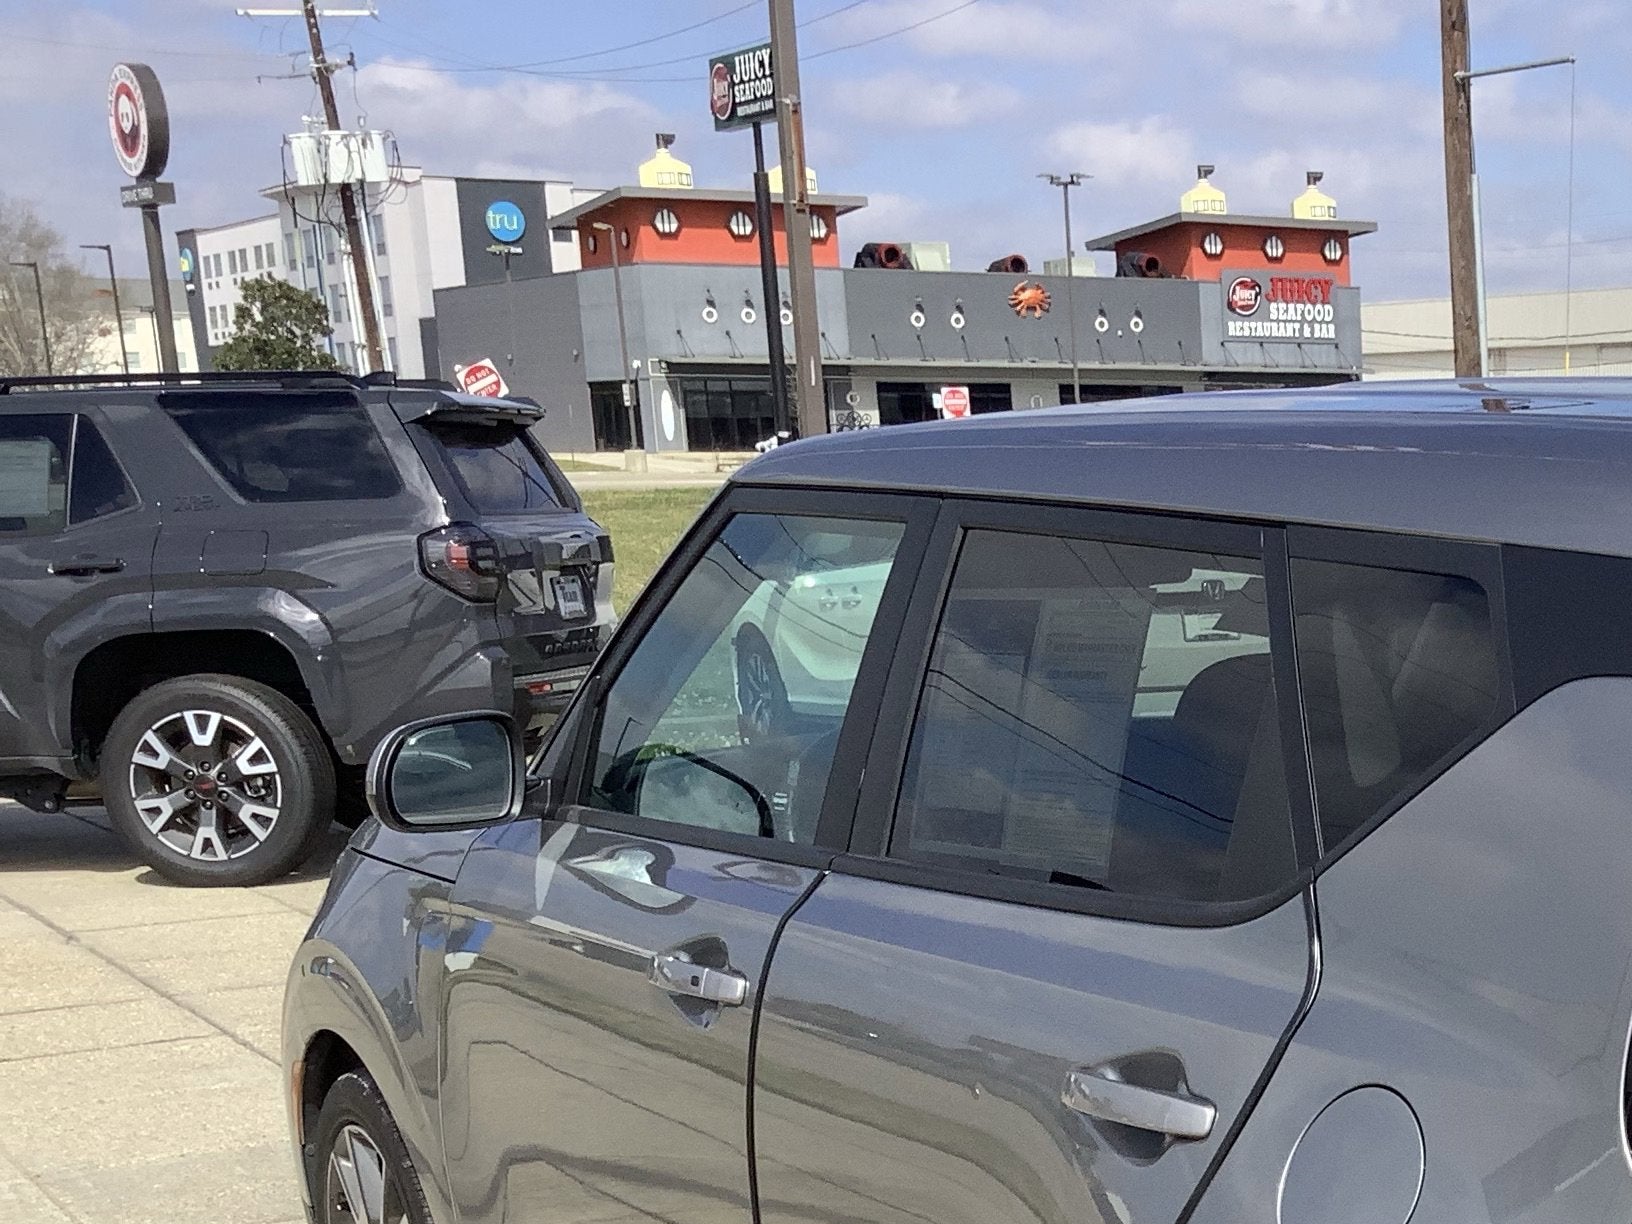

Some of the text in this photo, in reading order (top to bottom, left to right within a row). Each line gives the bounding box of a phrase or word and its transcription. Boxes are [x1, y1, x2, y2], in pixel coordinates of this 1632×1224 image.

[733, 48, 770, 83] JUICY
[734, 77, 773, 103] SEAFOOD
[487, 210, 518, 231] tru
[1264, 277, 1333, 304] JUICY
[1269, 302, 1334, 322] SEAFOOD
[1228, 320, 1335, 339] RESTAURANT & BAR
